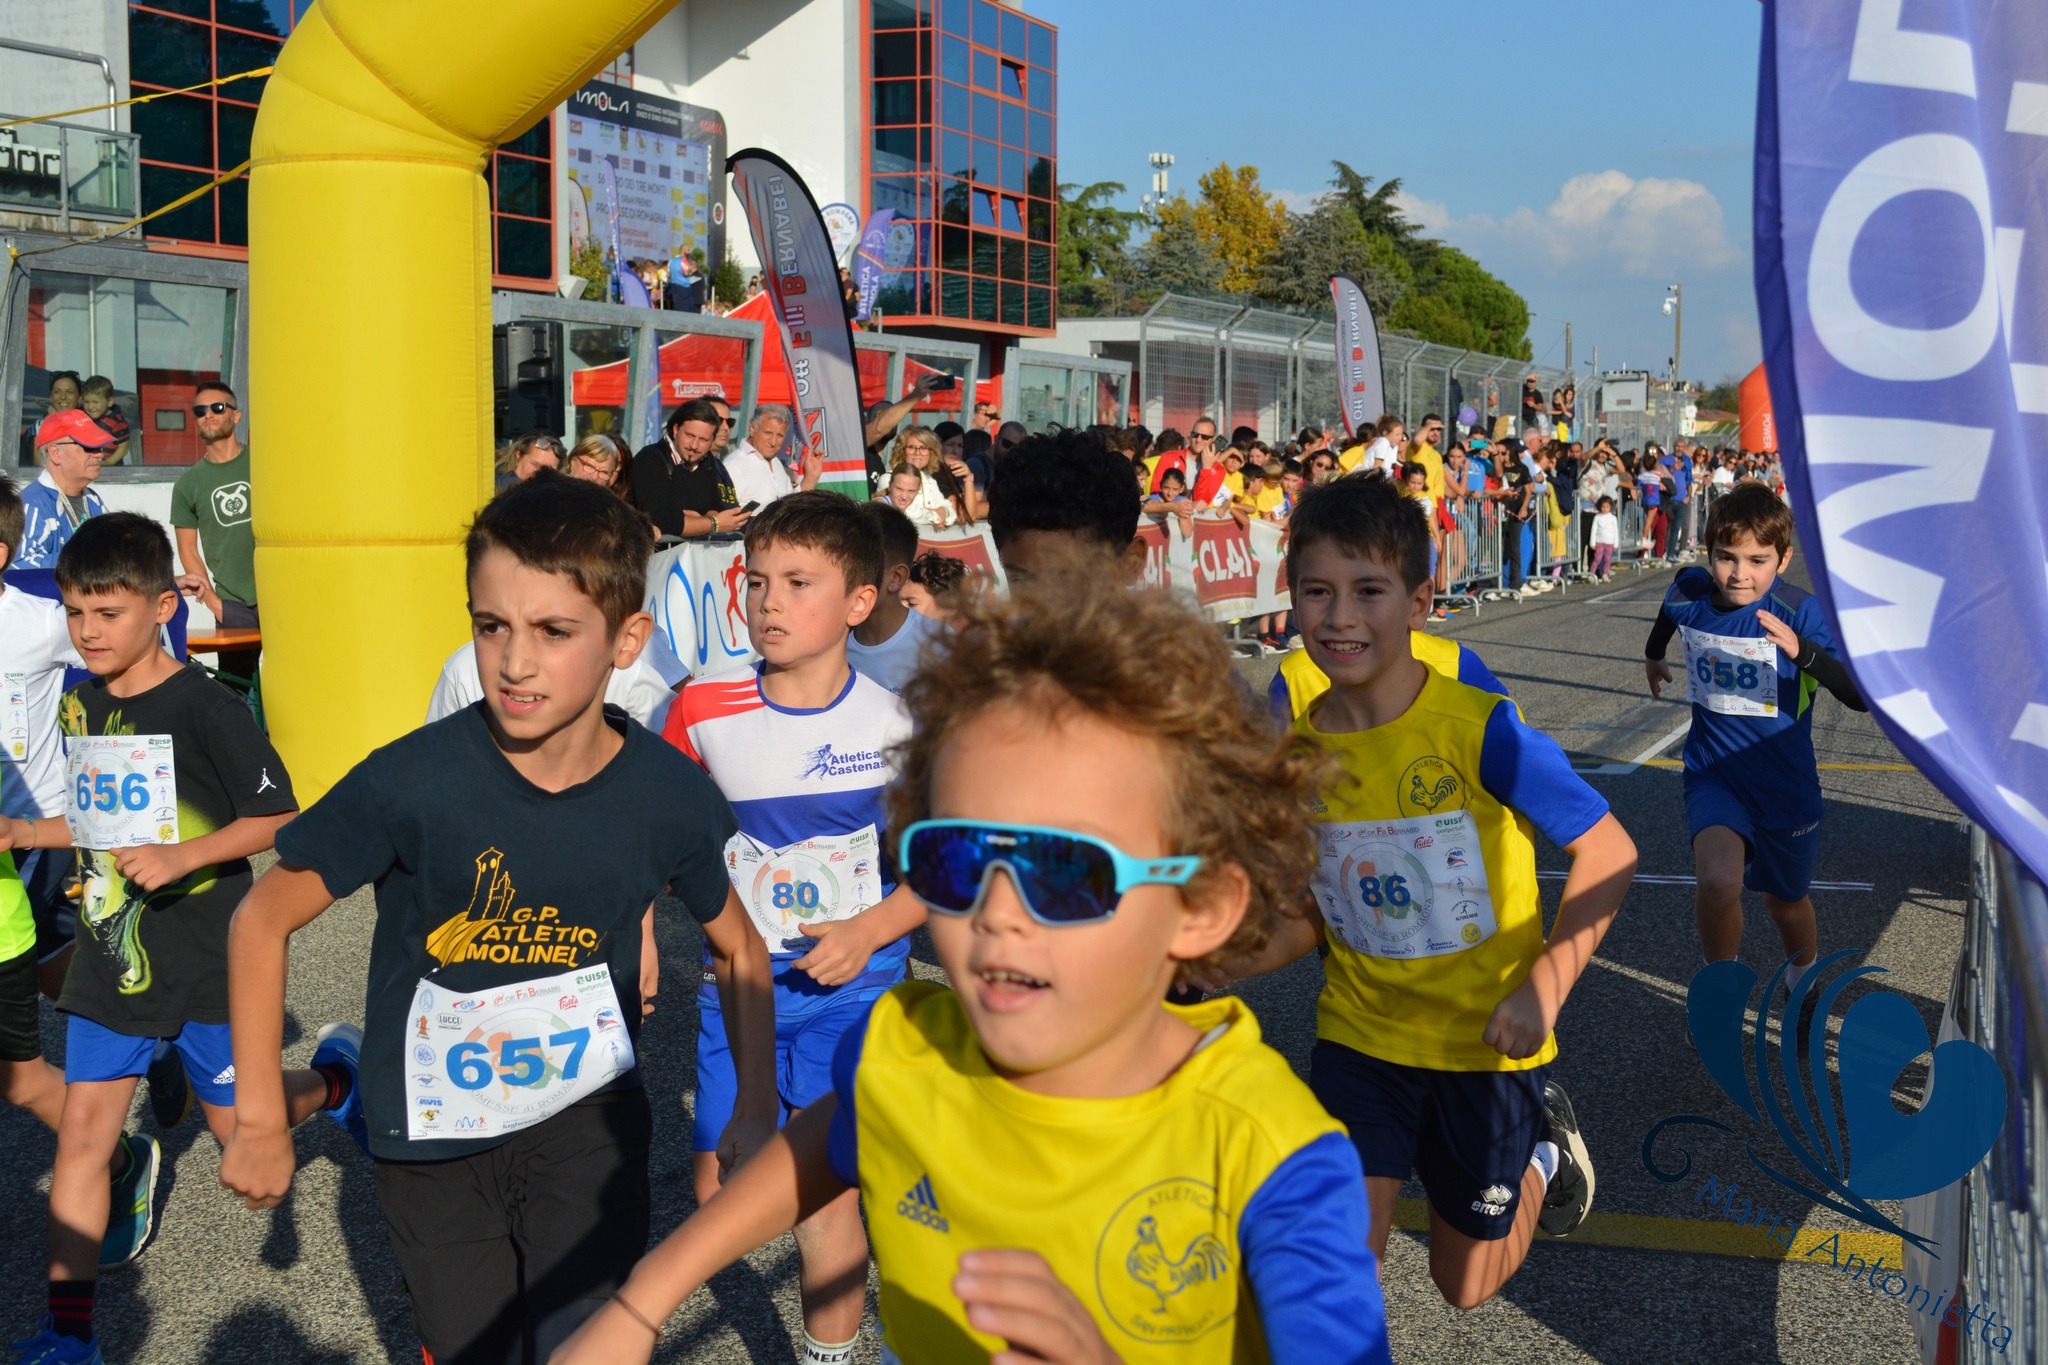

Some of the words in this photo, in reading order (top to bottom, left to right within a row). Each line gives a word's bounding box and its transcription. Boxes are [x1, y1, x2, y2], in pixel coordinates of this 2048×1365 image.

[576, 89, 630, 114] IMOLA
[859, 266, 871, 314] ATLETICA
[1762, 413, 1771, 449] POWER
[1143, 544, 1164, 588] AI
[1199, 537, 1253, 583] CLAI
[1696, 656, 1759, 689] 658
[828, 760, 889, 776] Castenas
[830, 750, 881, 766] Atletica
[1413, 759, 1444, 772] ATLETICA
[77, 773, 151, 812] 656
[1444, 816, 1463, 826] UISP
[772, 881, 820, 909] 80
[1359, 875, 1411, 907] 86
[512, 905, 561, 924] G.P.
[1400, 897, 1434, 938] ROMAGNA
[585, 970, 608, 982] UISP
[460, 1000, 476, 1010] GM
[439, 1015, 460, 1025] LUCCI
[446, 1026, 591, 1091] 657
[523, 1105, 535, 1113] di
[896, 1200, 951, 1234] adidas
